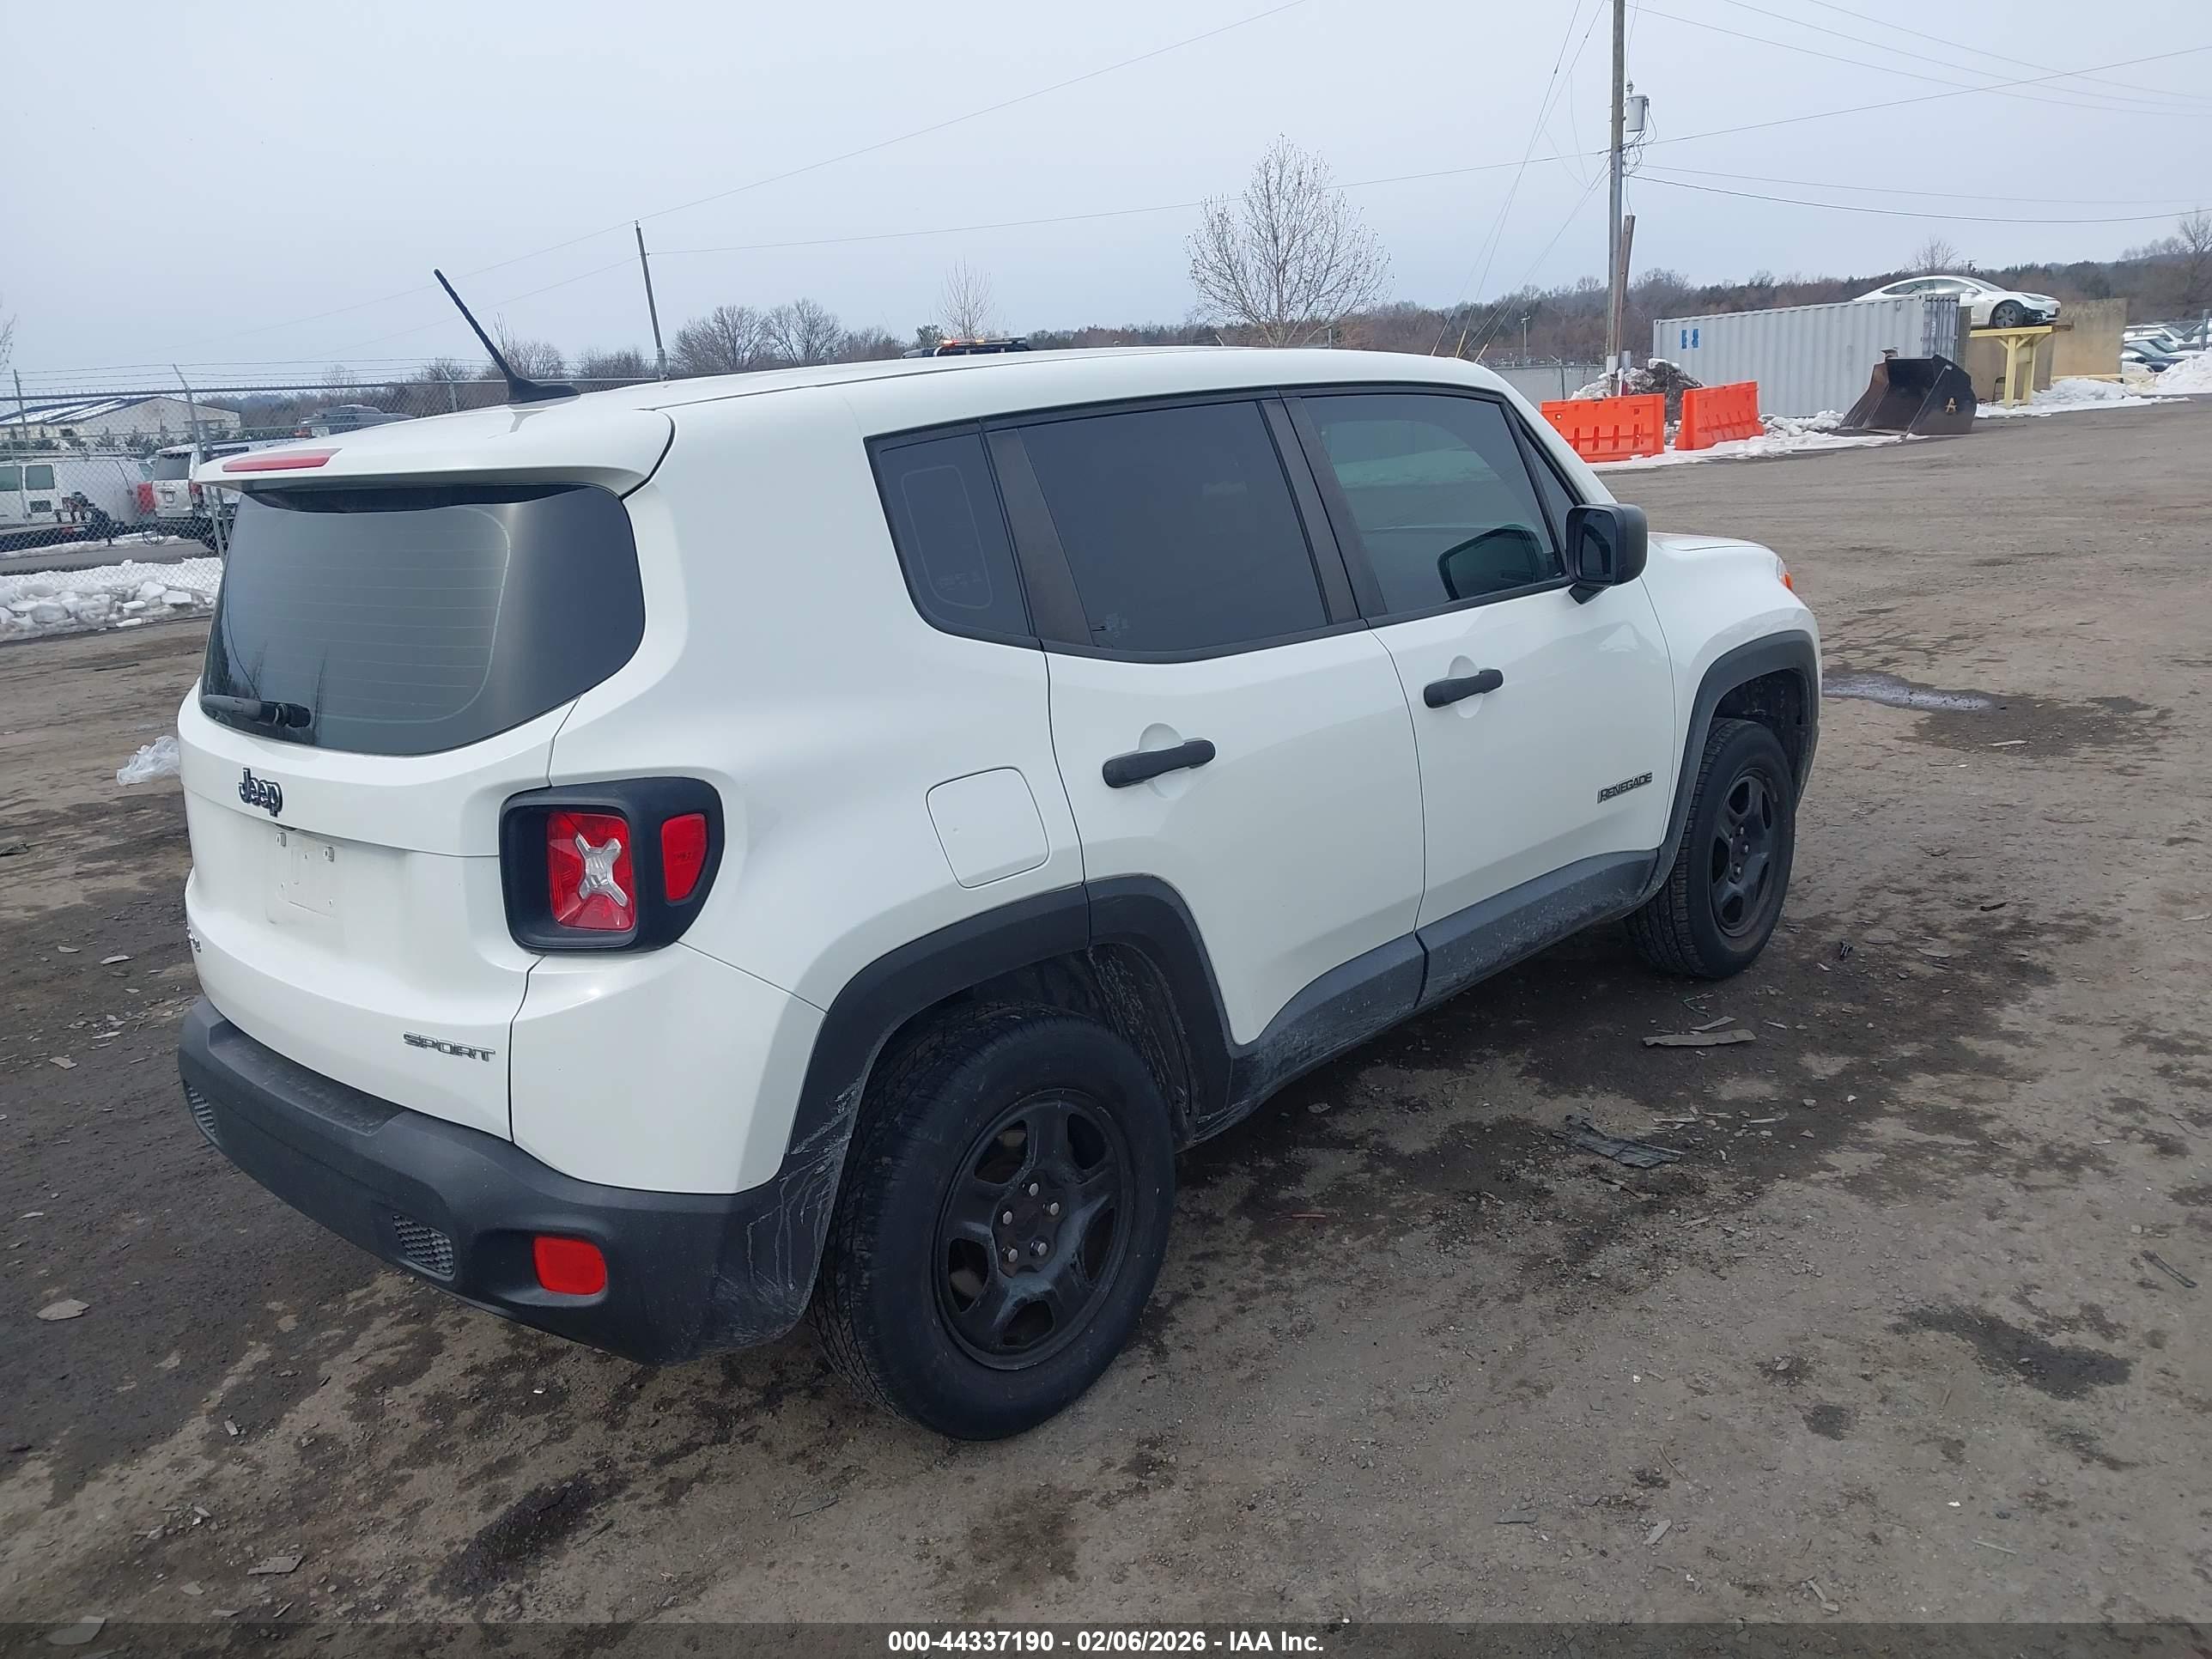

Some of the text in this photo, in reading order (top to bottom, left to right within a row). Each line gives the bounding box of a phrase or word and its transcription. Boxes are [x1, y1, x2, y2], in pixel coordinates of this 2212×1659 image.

[238, 768, 283, 817] Jeep
[1597, 771, 1653, 804] RENEGADE
[403, 1030, 495, 1062] SPORT
